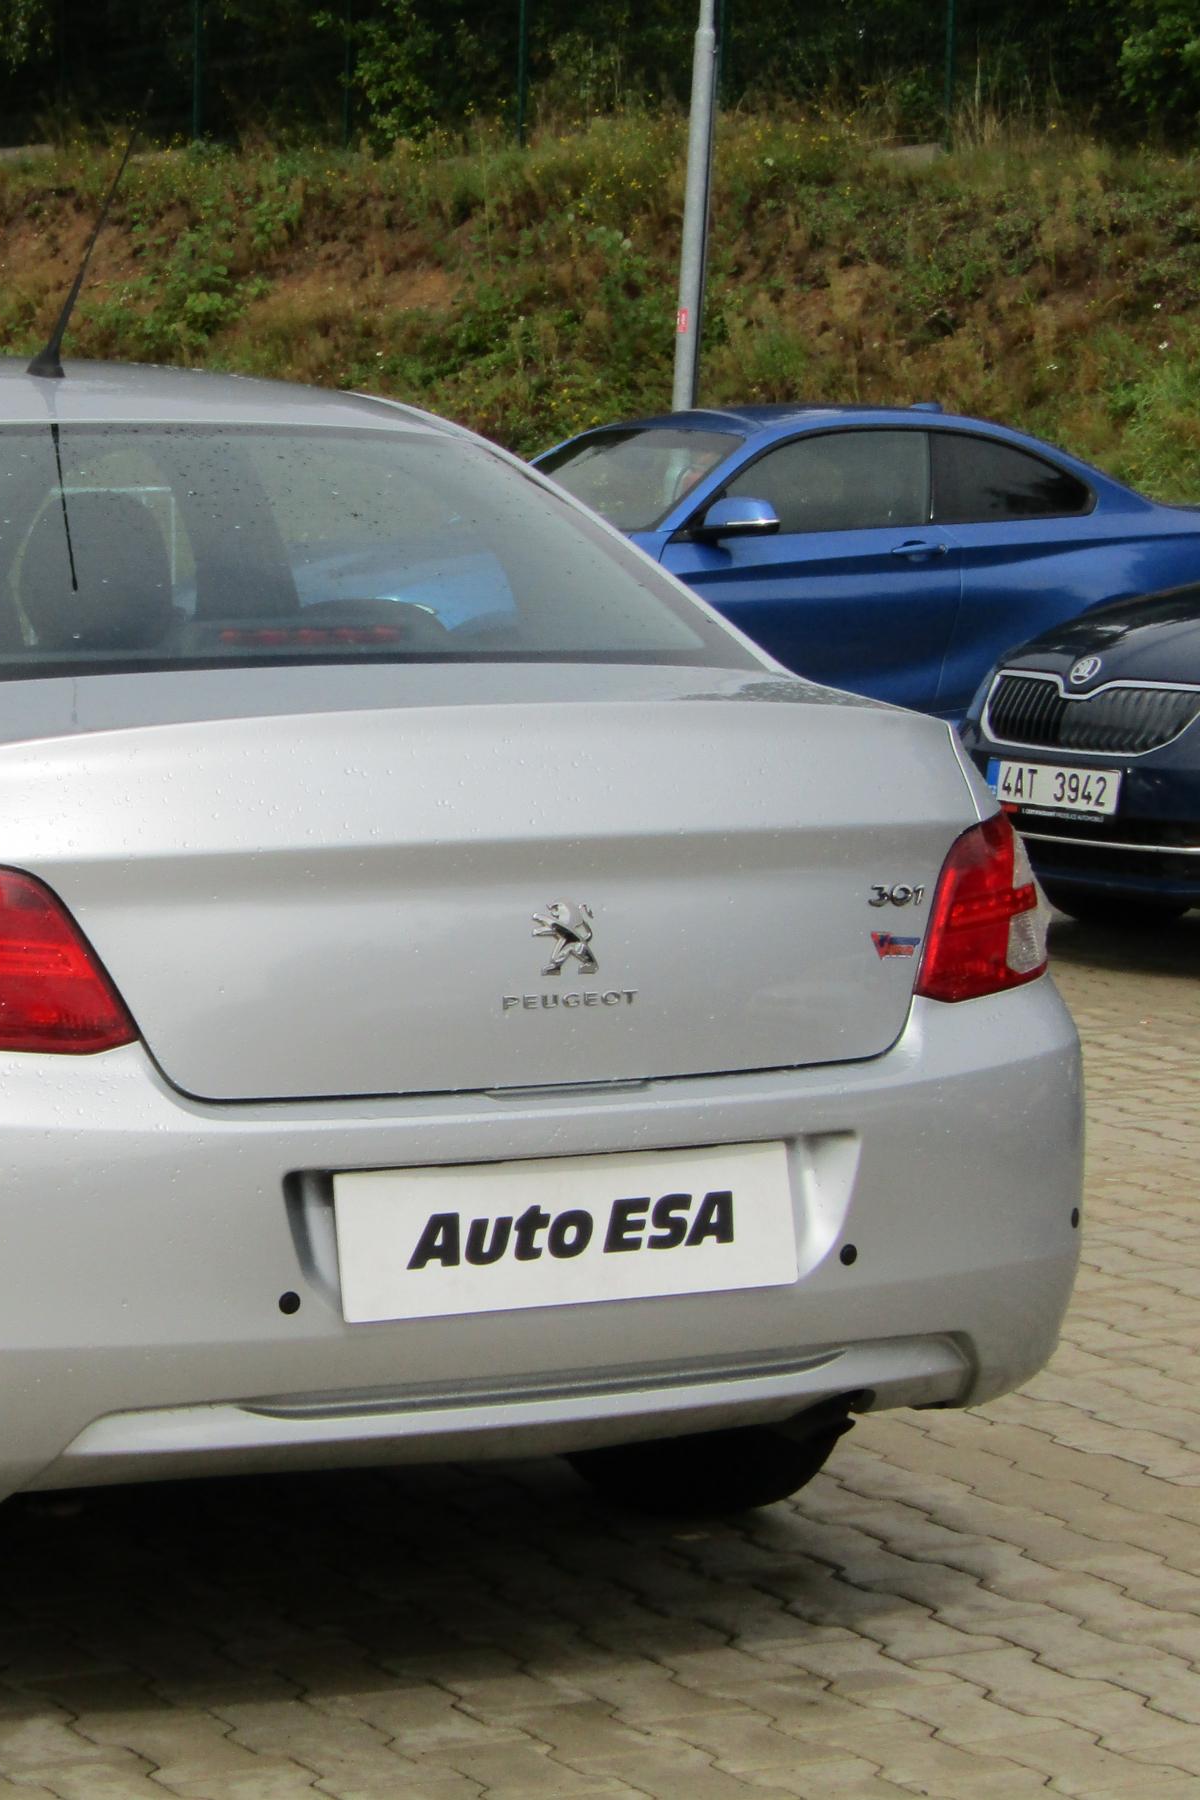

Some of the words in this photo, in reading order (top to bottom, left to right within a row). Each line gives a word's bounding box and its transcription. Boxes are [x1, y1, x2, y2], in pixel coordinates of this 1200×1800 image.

[1001, 766, 1038, 799] 4AT
[1053, 771, 1107, 807] 3942
[868, 884, 925, 907] 301
[502, 989, 639, 1010] PEUGEOT
[406, 1204, 594, 1270] Auto
[603, 1190, 734, 1254] ESA
